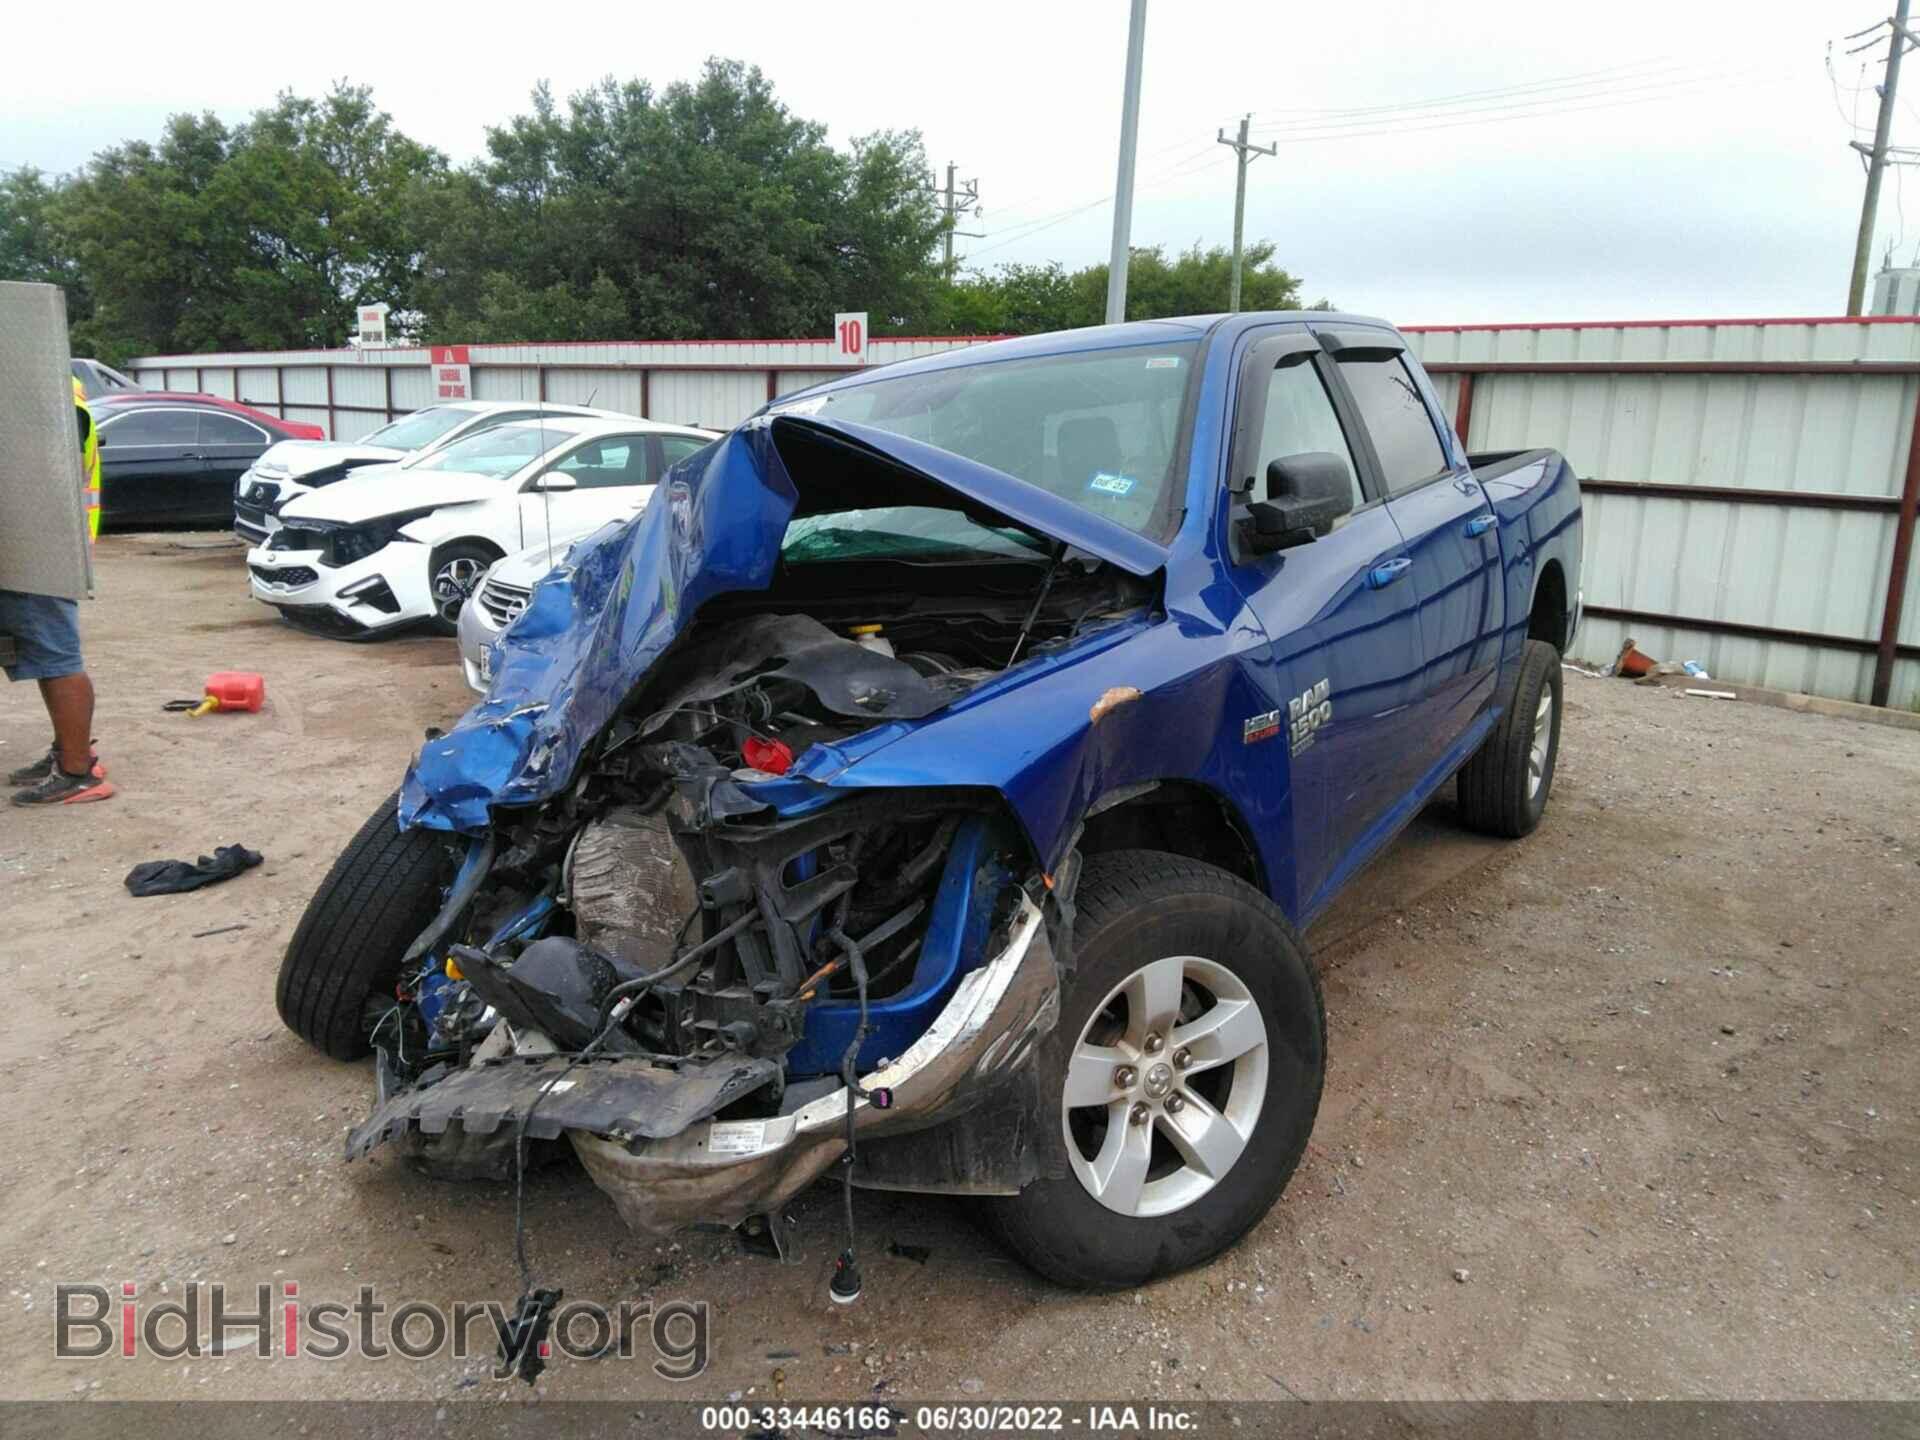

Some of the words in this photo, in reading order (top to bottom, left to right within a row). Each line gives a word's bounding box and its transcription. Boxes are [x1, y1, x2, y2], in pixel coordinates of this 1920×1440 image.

[838, 320, 861, 354] 10
[1289, 678, 1330, 722] RAM
[1290, 700, 1332, 743] 1500
